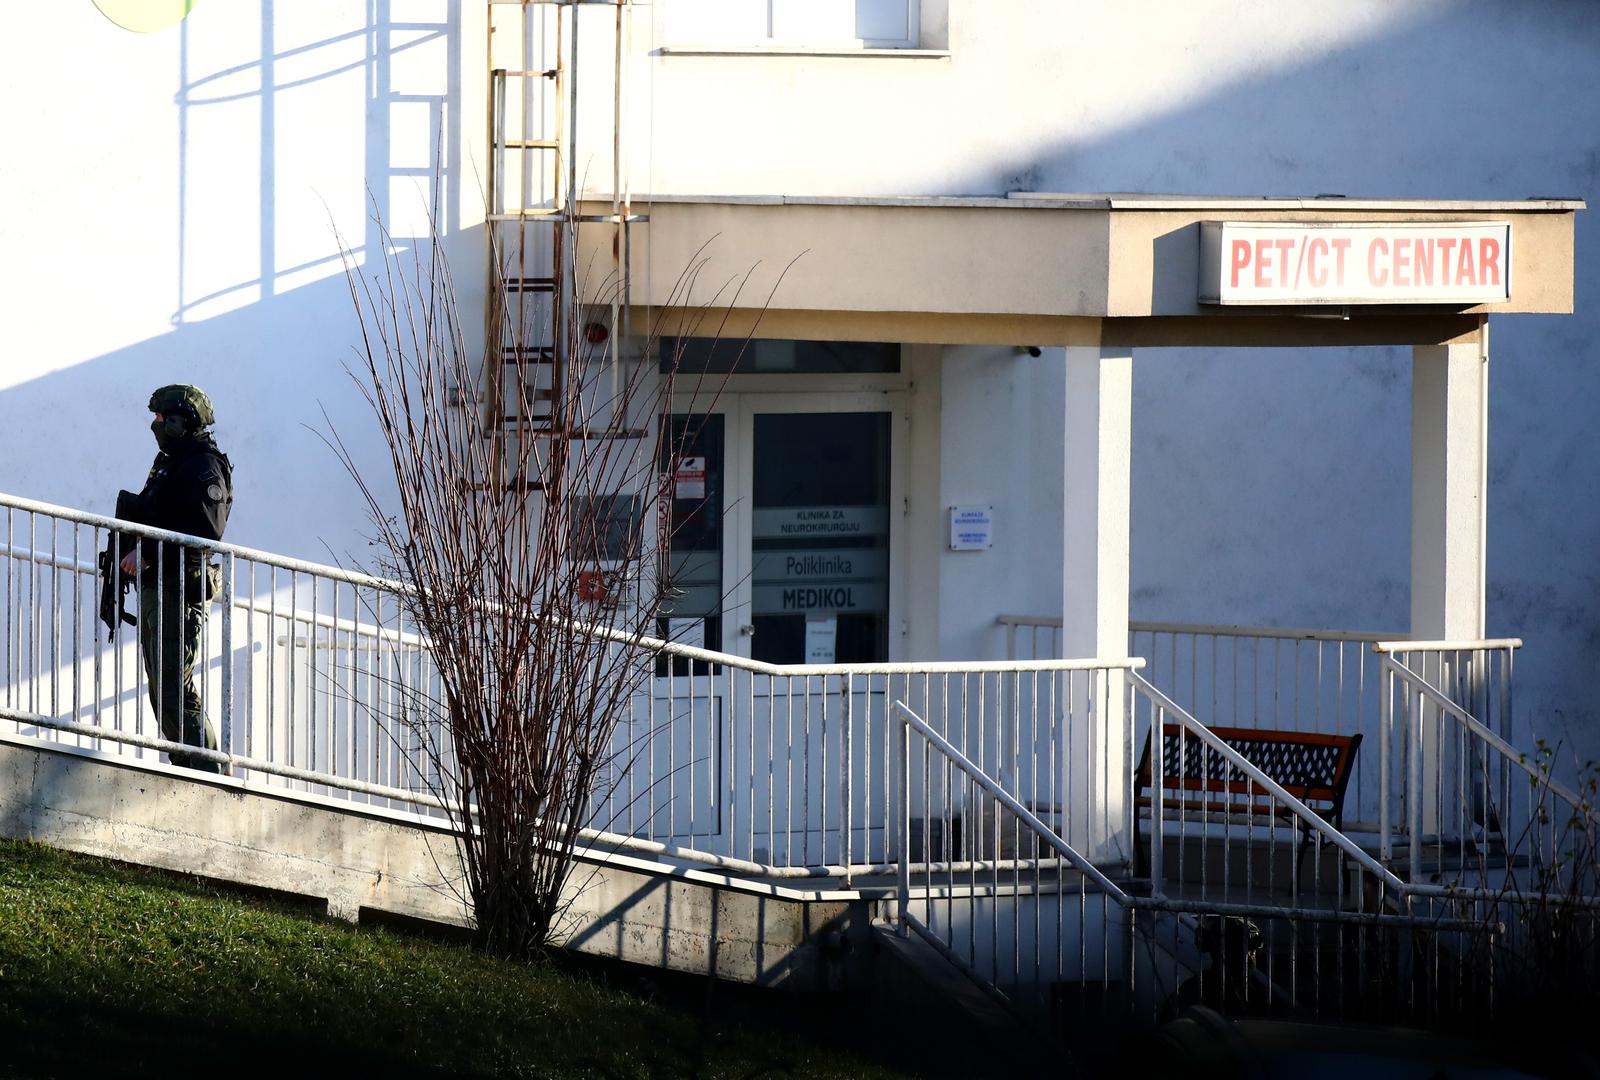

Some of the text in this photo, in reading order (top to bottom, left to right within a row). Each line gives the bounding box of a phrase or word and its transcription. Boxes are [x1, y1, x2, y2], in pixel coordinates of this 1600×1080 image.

[1230, 235, 1500, 290] PET/CT CENTAR
[796, 510, 845, 520] KLINIKA ZA
[780, 523, 860, 533] NEUROKIRURGIJU
[786, 556, 852, 575] Poliklinika
[783, 587, 856, 609] MEDIKOL
